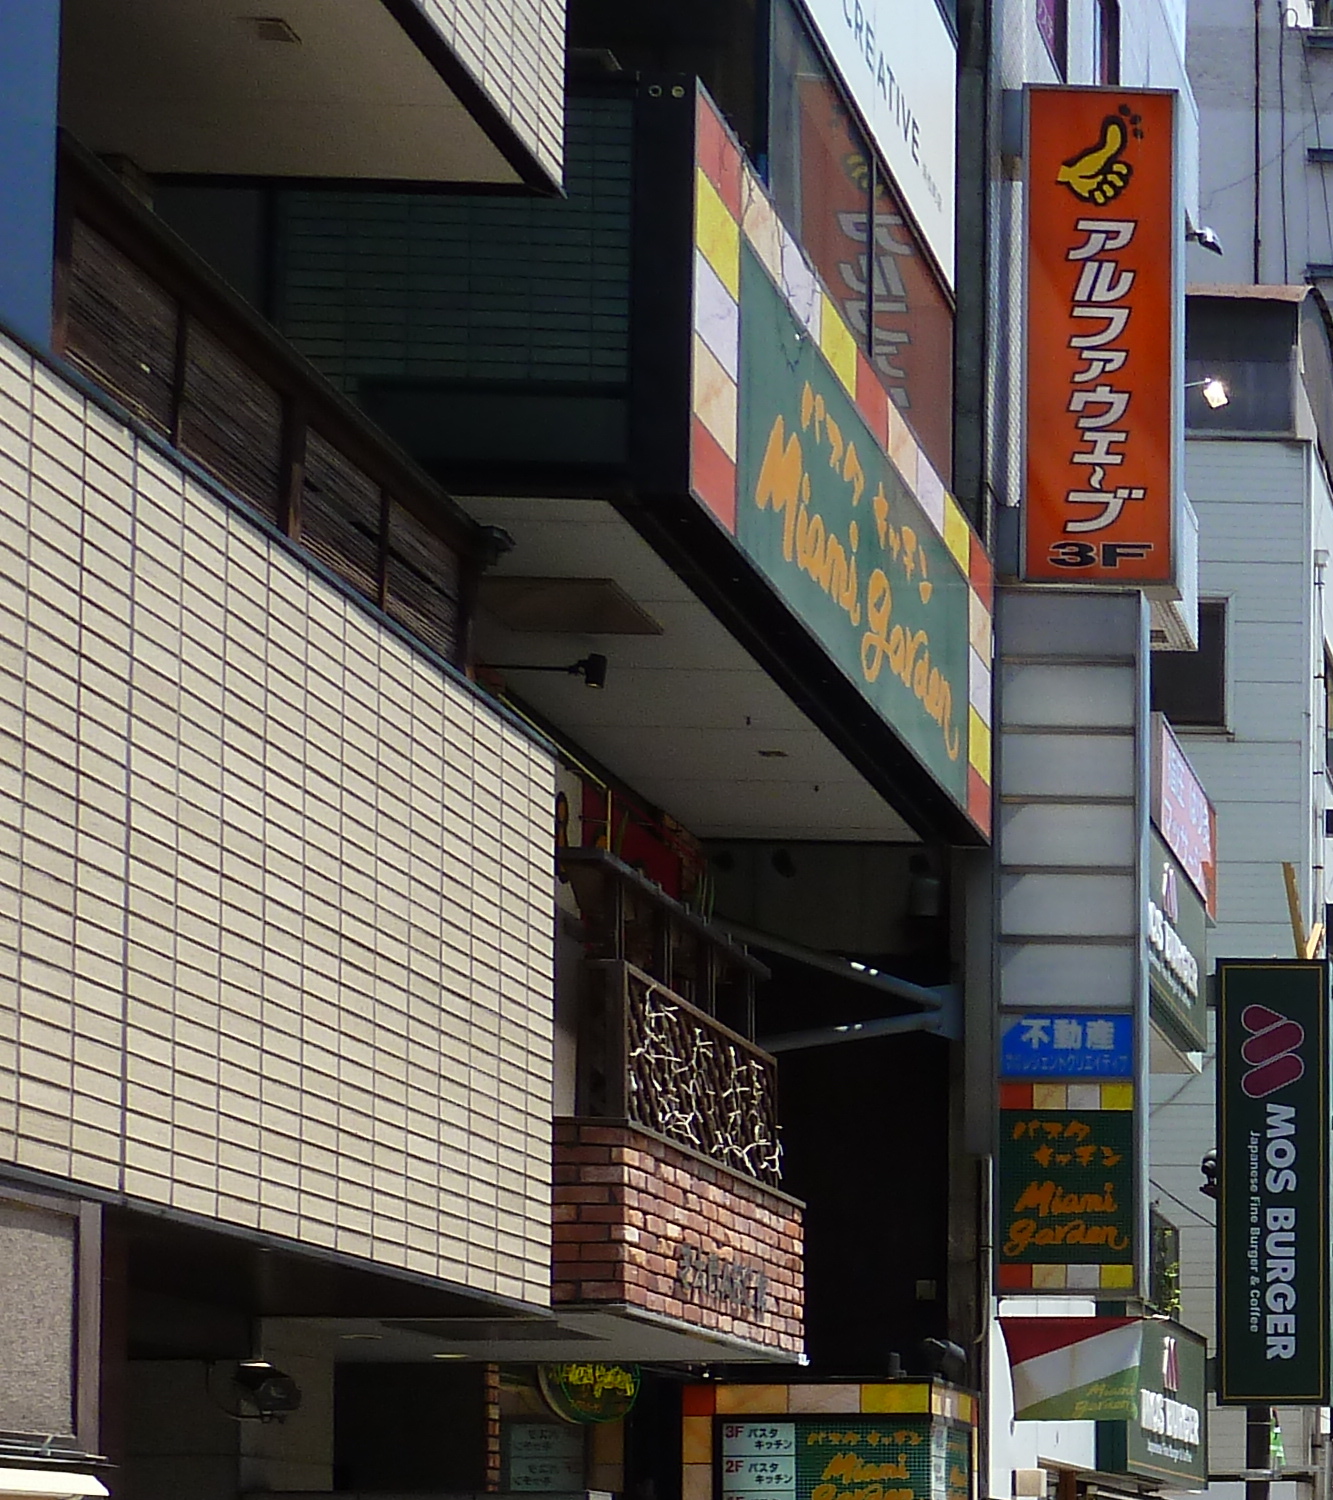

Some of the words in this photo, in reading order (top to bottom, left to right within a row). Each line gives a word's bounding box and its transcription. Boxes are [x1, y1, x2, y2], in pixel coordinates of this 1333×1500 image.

[754, 414, 862, 628] Miami
[1048, 542, 1154, 568] 3F
[1020, 1018, 1116, 1050] 不動産
[1248, 1130, 1260, 1192] Japanese
[1264, 1102, 1298, 1196] MOS
[1014, 1180, 1118, 1214] Miami
[1248, 1196, 1260, 1224] Fine
[1246, 1226, 1260, 1270] Burger
[1264, 1206, 1298, 1362] BURGER
[1248, 1286, 1260, 1334] Coffee
[724, 1424, 744, 1438] 3F
[748, 1426, 778, 1440] パスタ
[754, 1438, 794, 1450] キッチン
[724, 1460, 744, 1474] 2F
[748, 1462, 778, 1474] パスタ
[754, 1474, 794, 1486] キッチン
[820, 1452, 910, 1484] Miami
